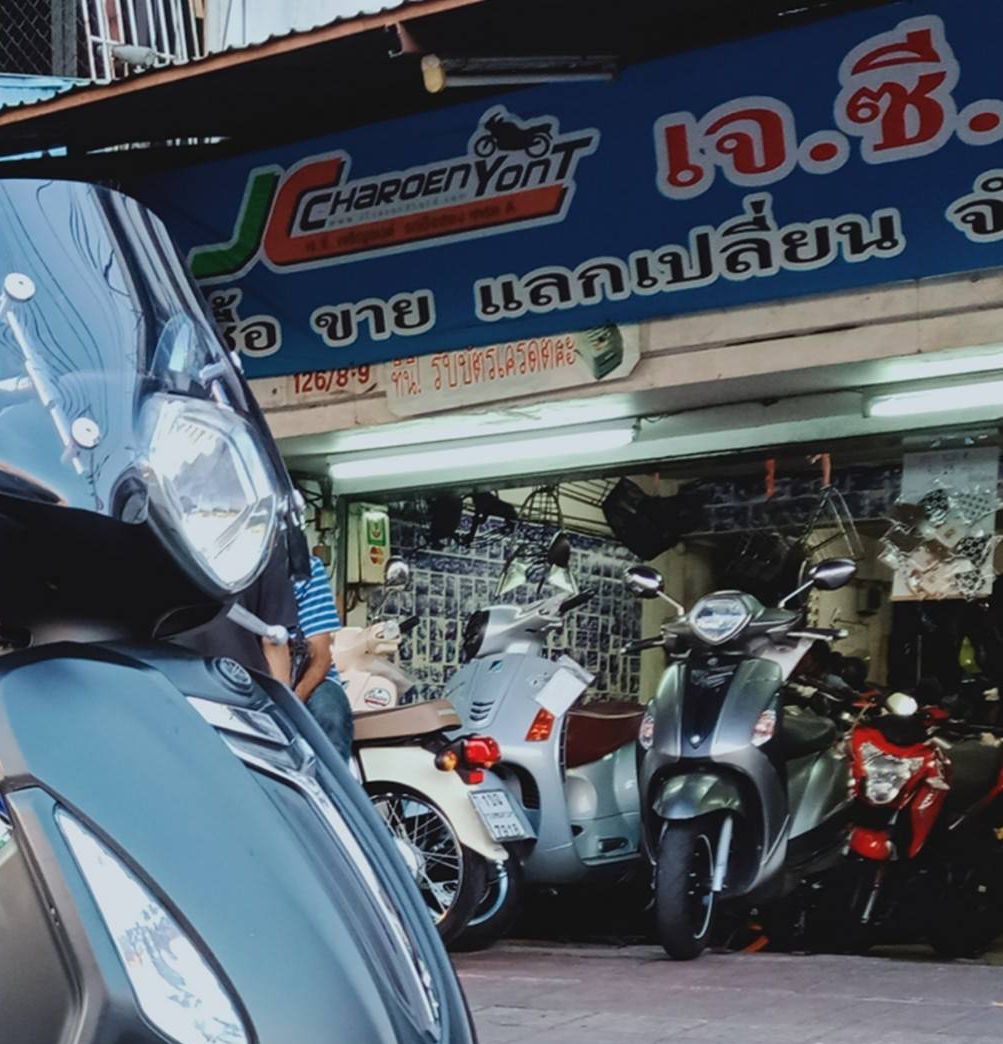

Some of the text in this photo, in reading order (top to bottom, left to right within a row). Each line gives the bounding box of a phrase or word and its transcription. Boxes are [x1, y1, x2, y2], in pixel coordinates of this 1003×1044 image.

[315, 294, 430, 341] ขาย
[481, 201, 898, 315] แลกเปลี่ยน
